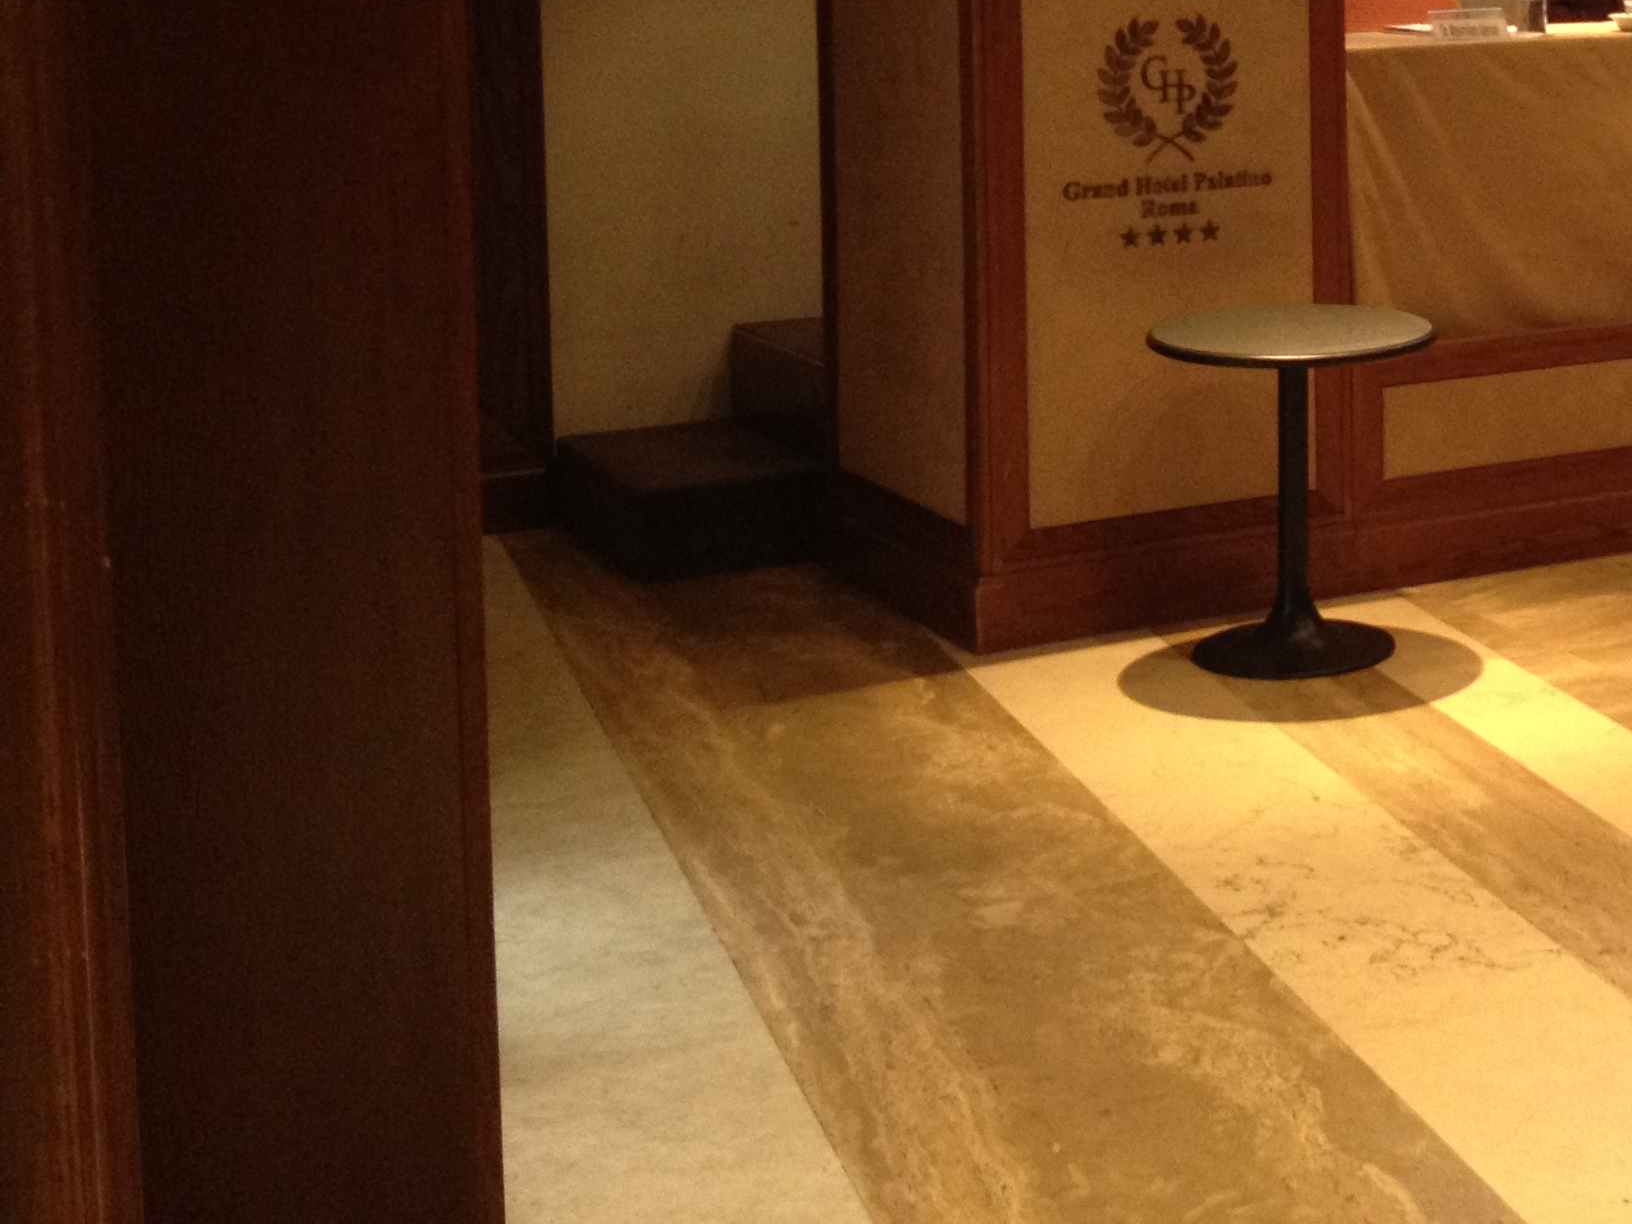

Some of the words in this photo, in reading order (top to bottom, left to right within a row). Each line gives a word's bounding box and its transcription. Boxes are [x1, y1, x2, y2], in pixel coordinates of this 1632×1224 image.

[1063, 178, 1129, 202] Grand
[1136, 174, 1188, 196] Hotel
[1194, 169, 1273, 191] Palatino
[1140, 199, 1197, 219] Roma
